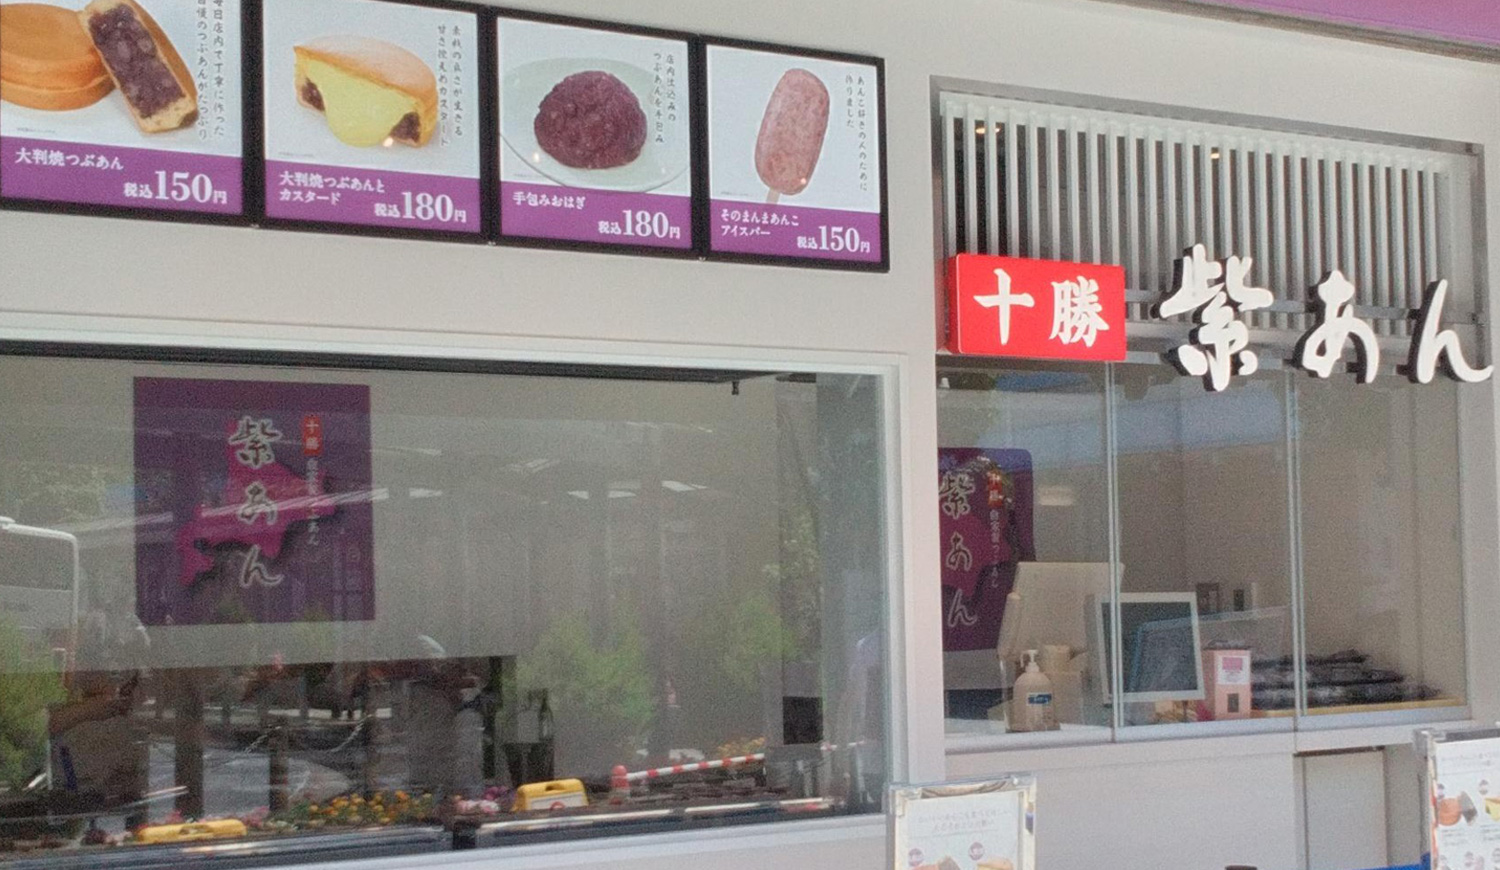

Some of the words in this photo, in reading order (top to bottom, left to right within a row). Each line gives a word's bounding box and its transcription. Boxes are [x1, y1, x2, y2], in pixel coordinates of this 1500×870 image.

[15, 147, 124, 171] 大判焼つぶあん
[123, 169, 228, 205] 税込150円
[279, 170, 386, 193] 大判焼つぶあんと
[279, 188, 341, 206] カスタード
[374, 191, 467, 223] 税込180円
[513, 191, 586, 210] 手包みおはぎ
[598, 209, 681, 239] 税込180円
[721, 208, 800, 226] そのまんまあんこ
[721, 225, 771, 238] アイスバー
[797, 225, 871, 253] 税込150円
[973, 268, 1110, 347] 十勝
[1157, 243, 1495, 392] 紫あん
[229, 415, 284, 589] 紫あん
